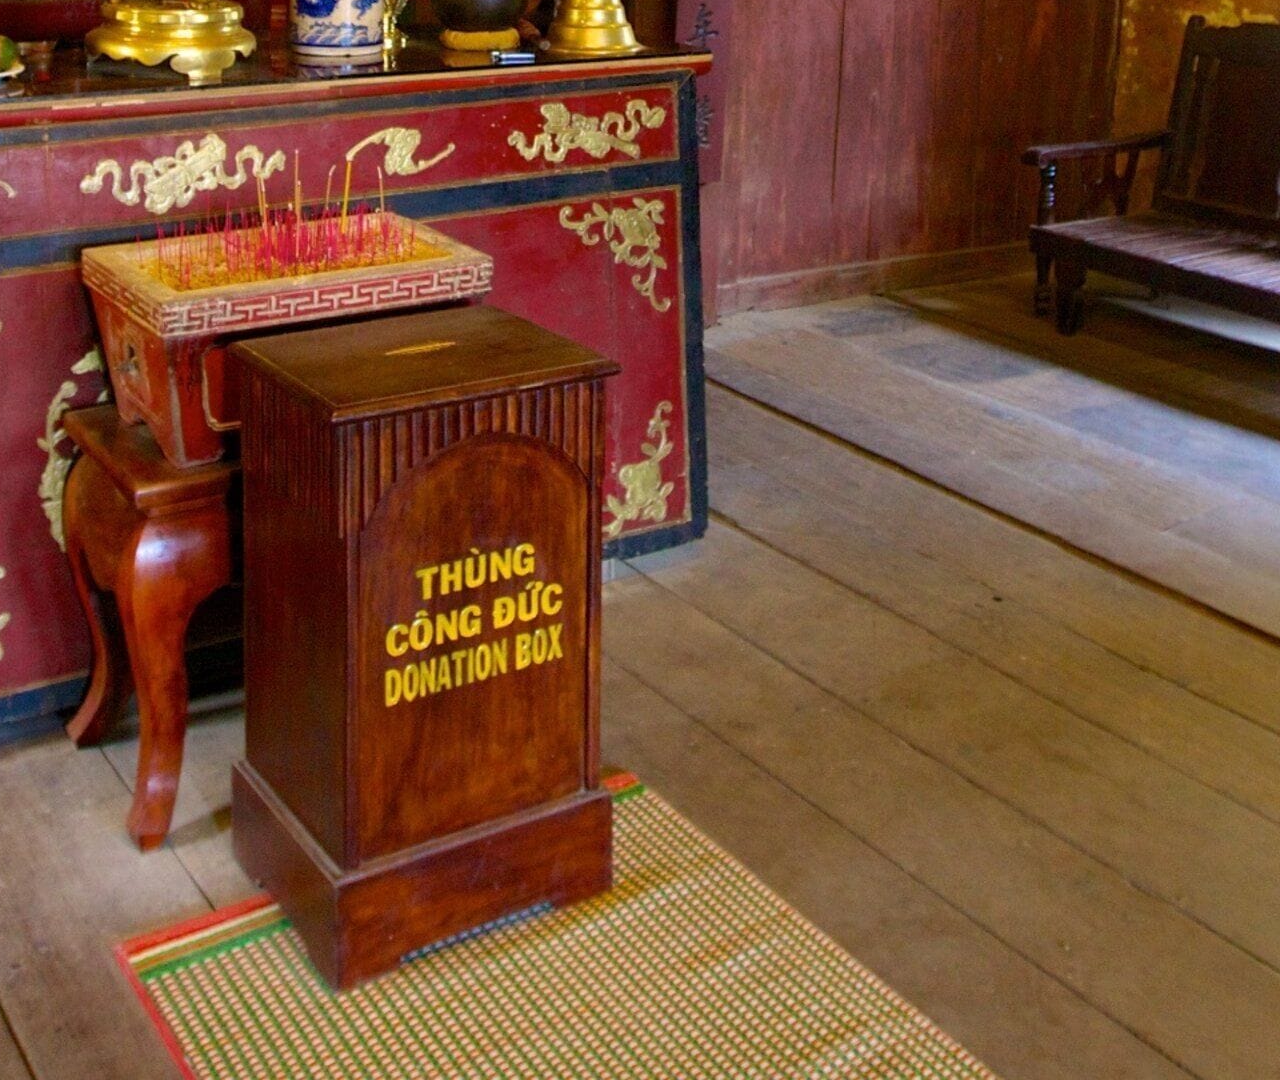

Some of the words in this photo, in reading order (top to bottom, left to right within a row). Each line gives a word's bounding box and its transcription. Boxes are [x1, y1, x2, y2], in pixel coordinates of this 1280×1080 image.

[416, 543, 535, 599] THÙNG
[385, 605, 482, 656] CÔNG
[493, 581, 563, 629] ĐỨC
[385, 638, 508, 707] DONATION
[515, 624, 563, 670] BOX
